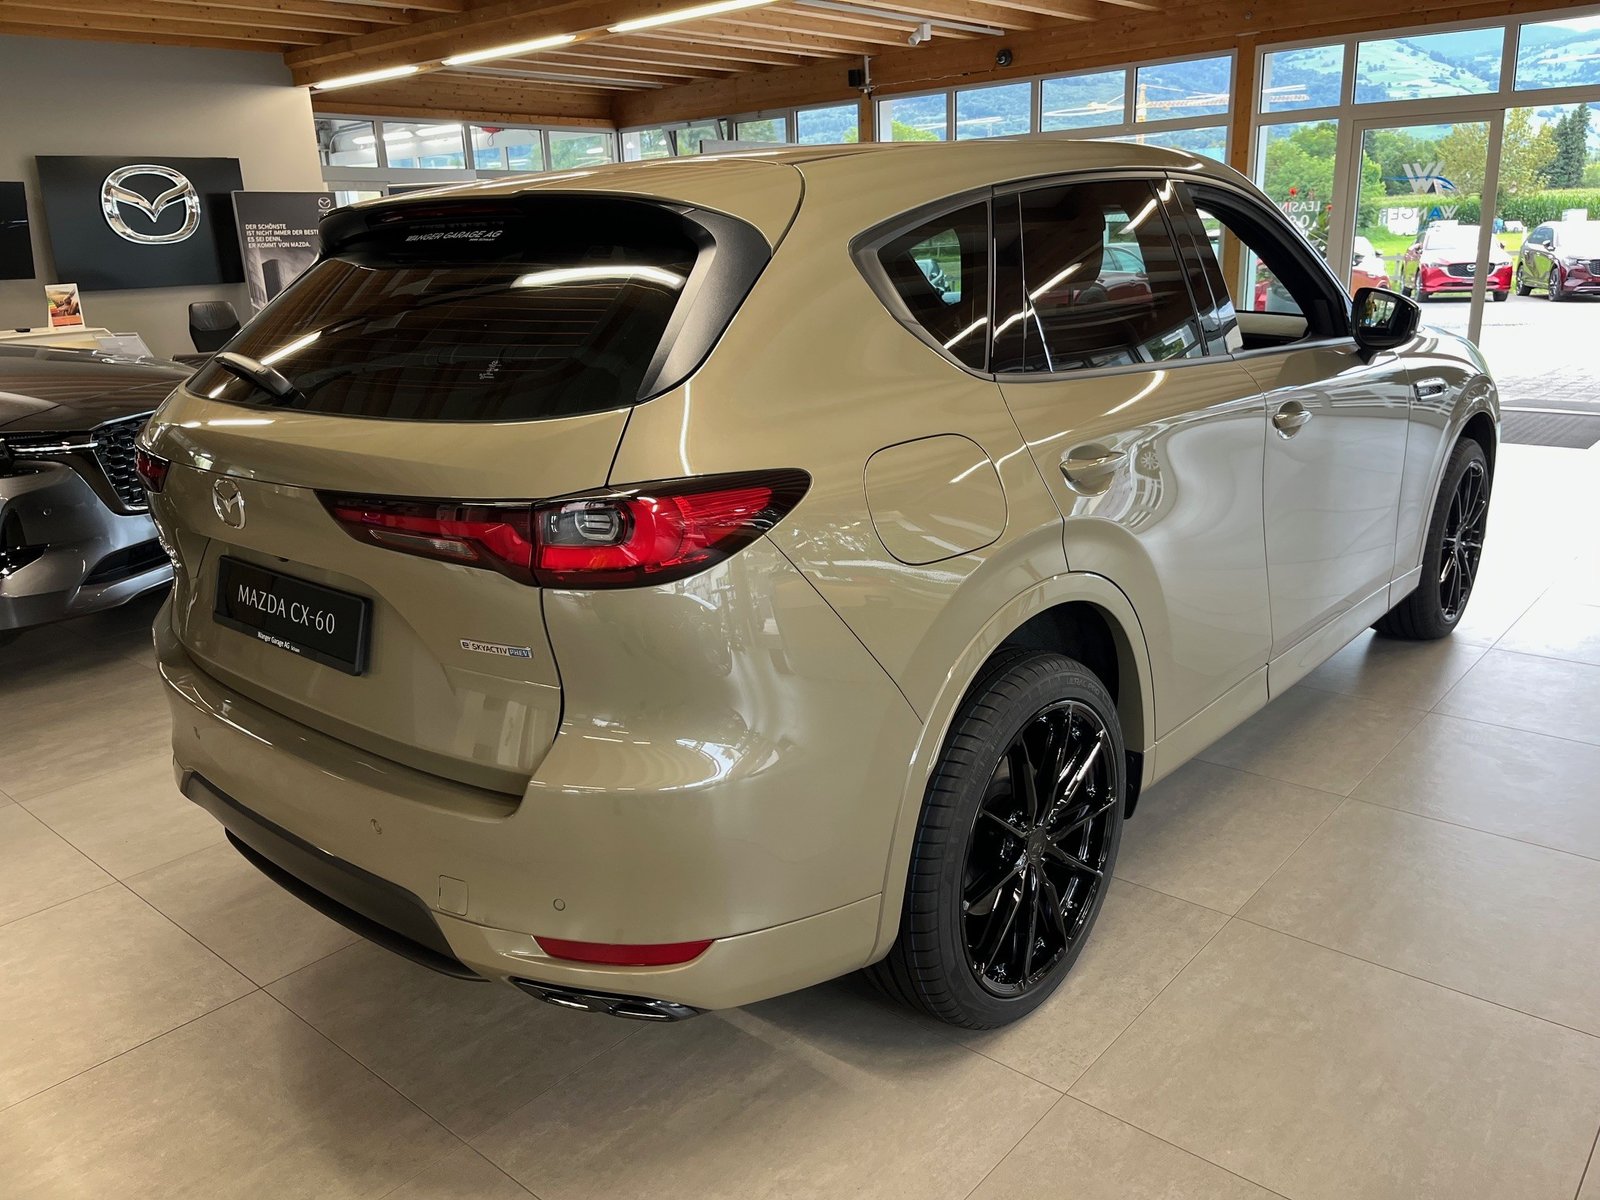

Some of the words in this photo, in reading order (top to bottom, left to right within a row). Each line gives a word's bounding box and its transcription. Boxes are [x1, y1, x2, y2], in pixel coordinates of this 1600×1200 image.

[257, 222, 287, 230] SCHÖNSTE
[405, 232, 445, 242] WANGER
[443, 230, 487, 239] GARAGE
[483, 230, 503, 238] AG
[237, 584, 286, 619] MAZDA
[290, 602, 335, 634] CX-60
[257, 631, 271, 643] Wanger
[271, 636, 284, 648] Garage
[283, 641, 290, 650] AG
[472, 643, 508, 655] SKYACTIV
